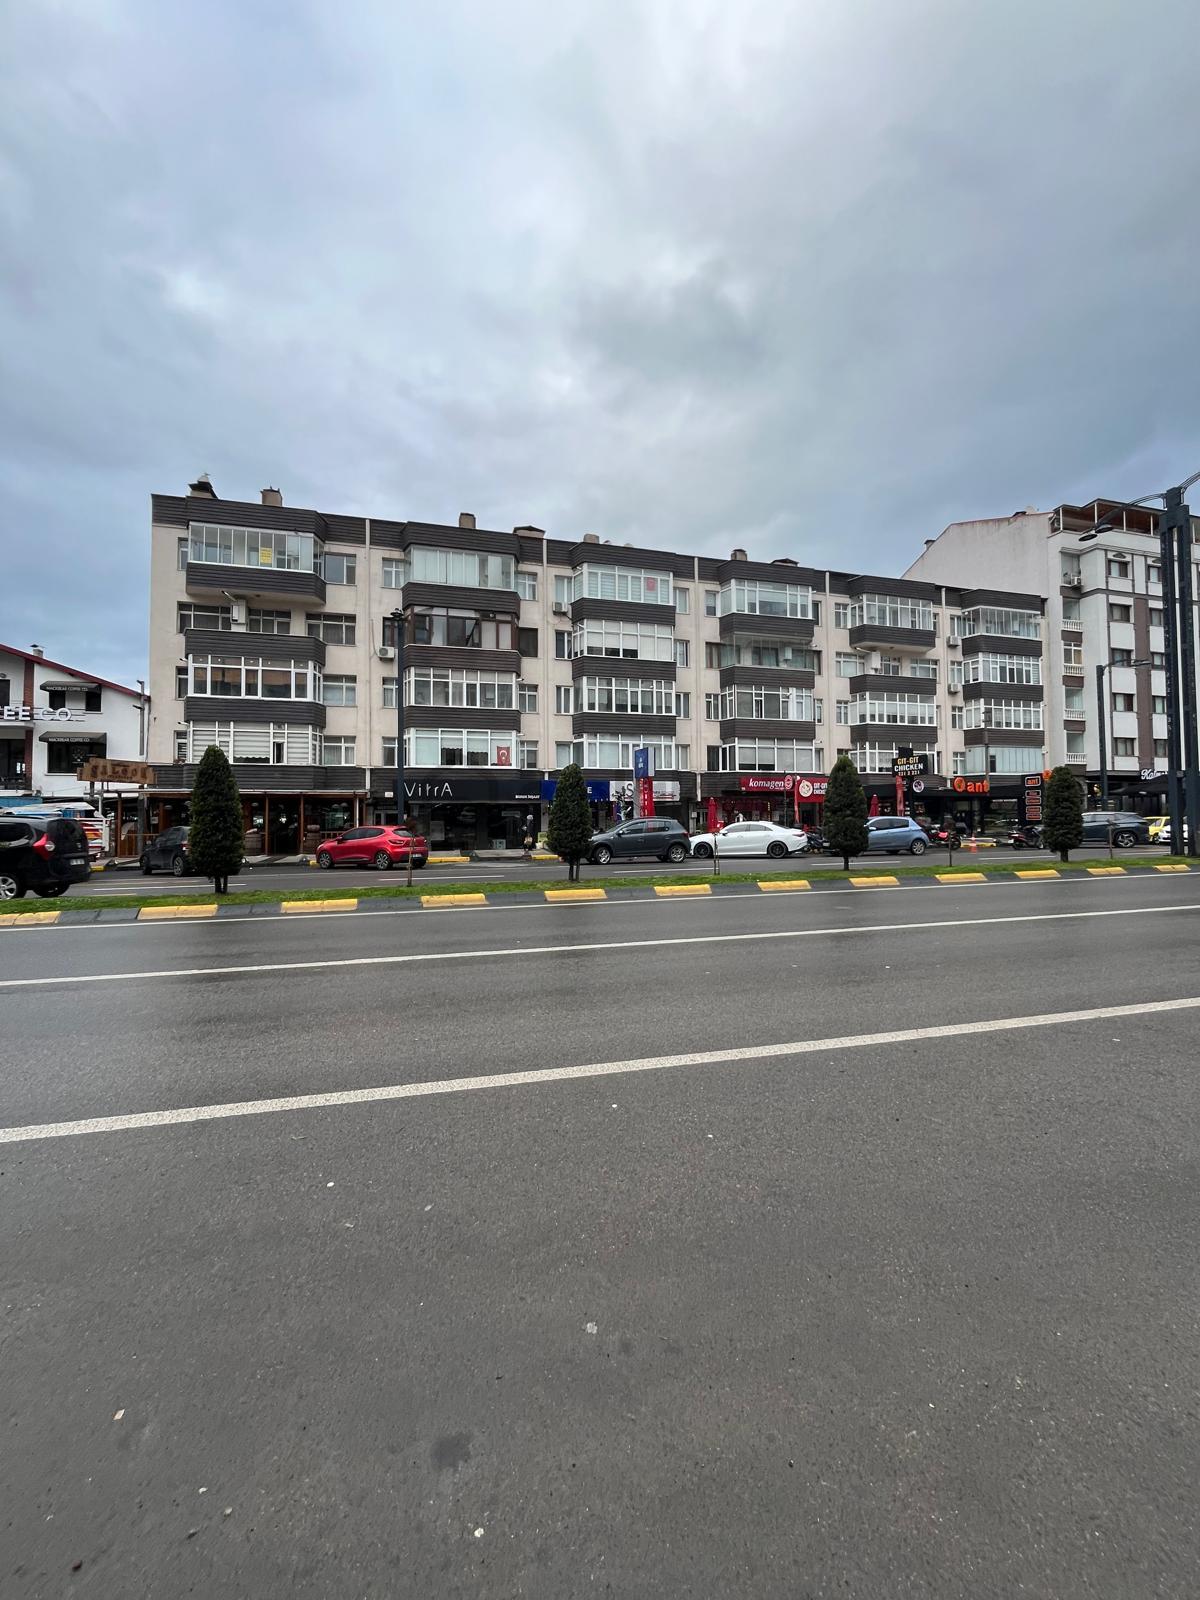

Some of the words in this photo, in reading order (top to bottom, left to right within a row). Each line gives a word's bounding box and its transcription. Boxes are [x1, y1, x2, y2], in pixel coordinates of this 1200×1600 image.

[3, 706, 30, 720] EE
[41, 707, 72, 721] CO
[894, 763, 924, 772] CHICKEN
[749, 777, 784, 789] komagen
[967, 780, 990, 792] ant
[403, 782, 453, 797] VitrA
